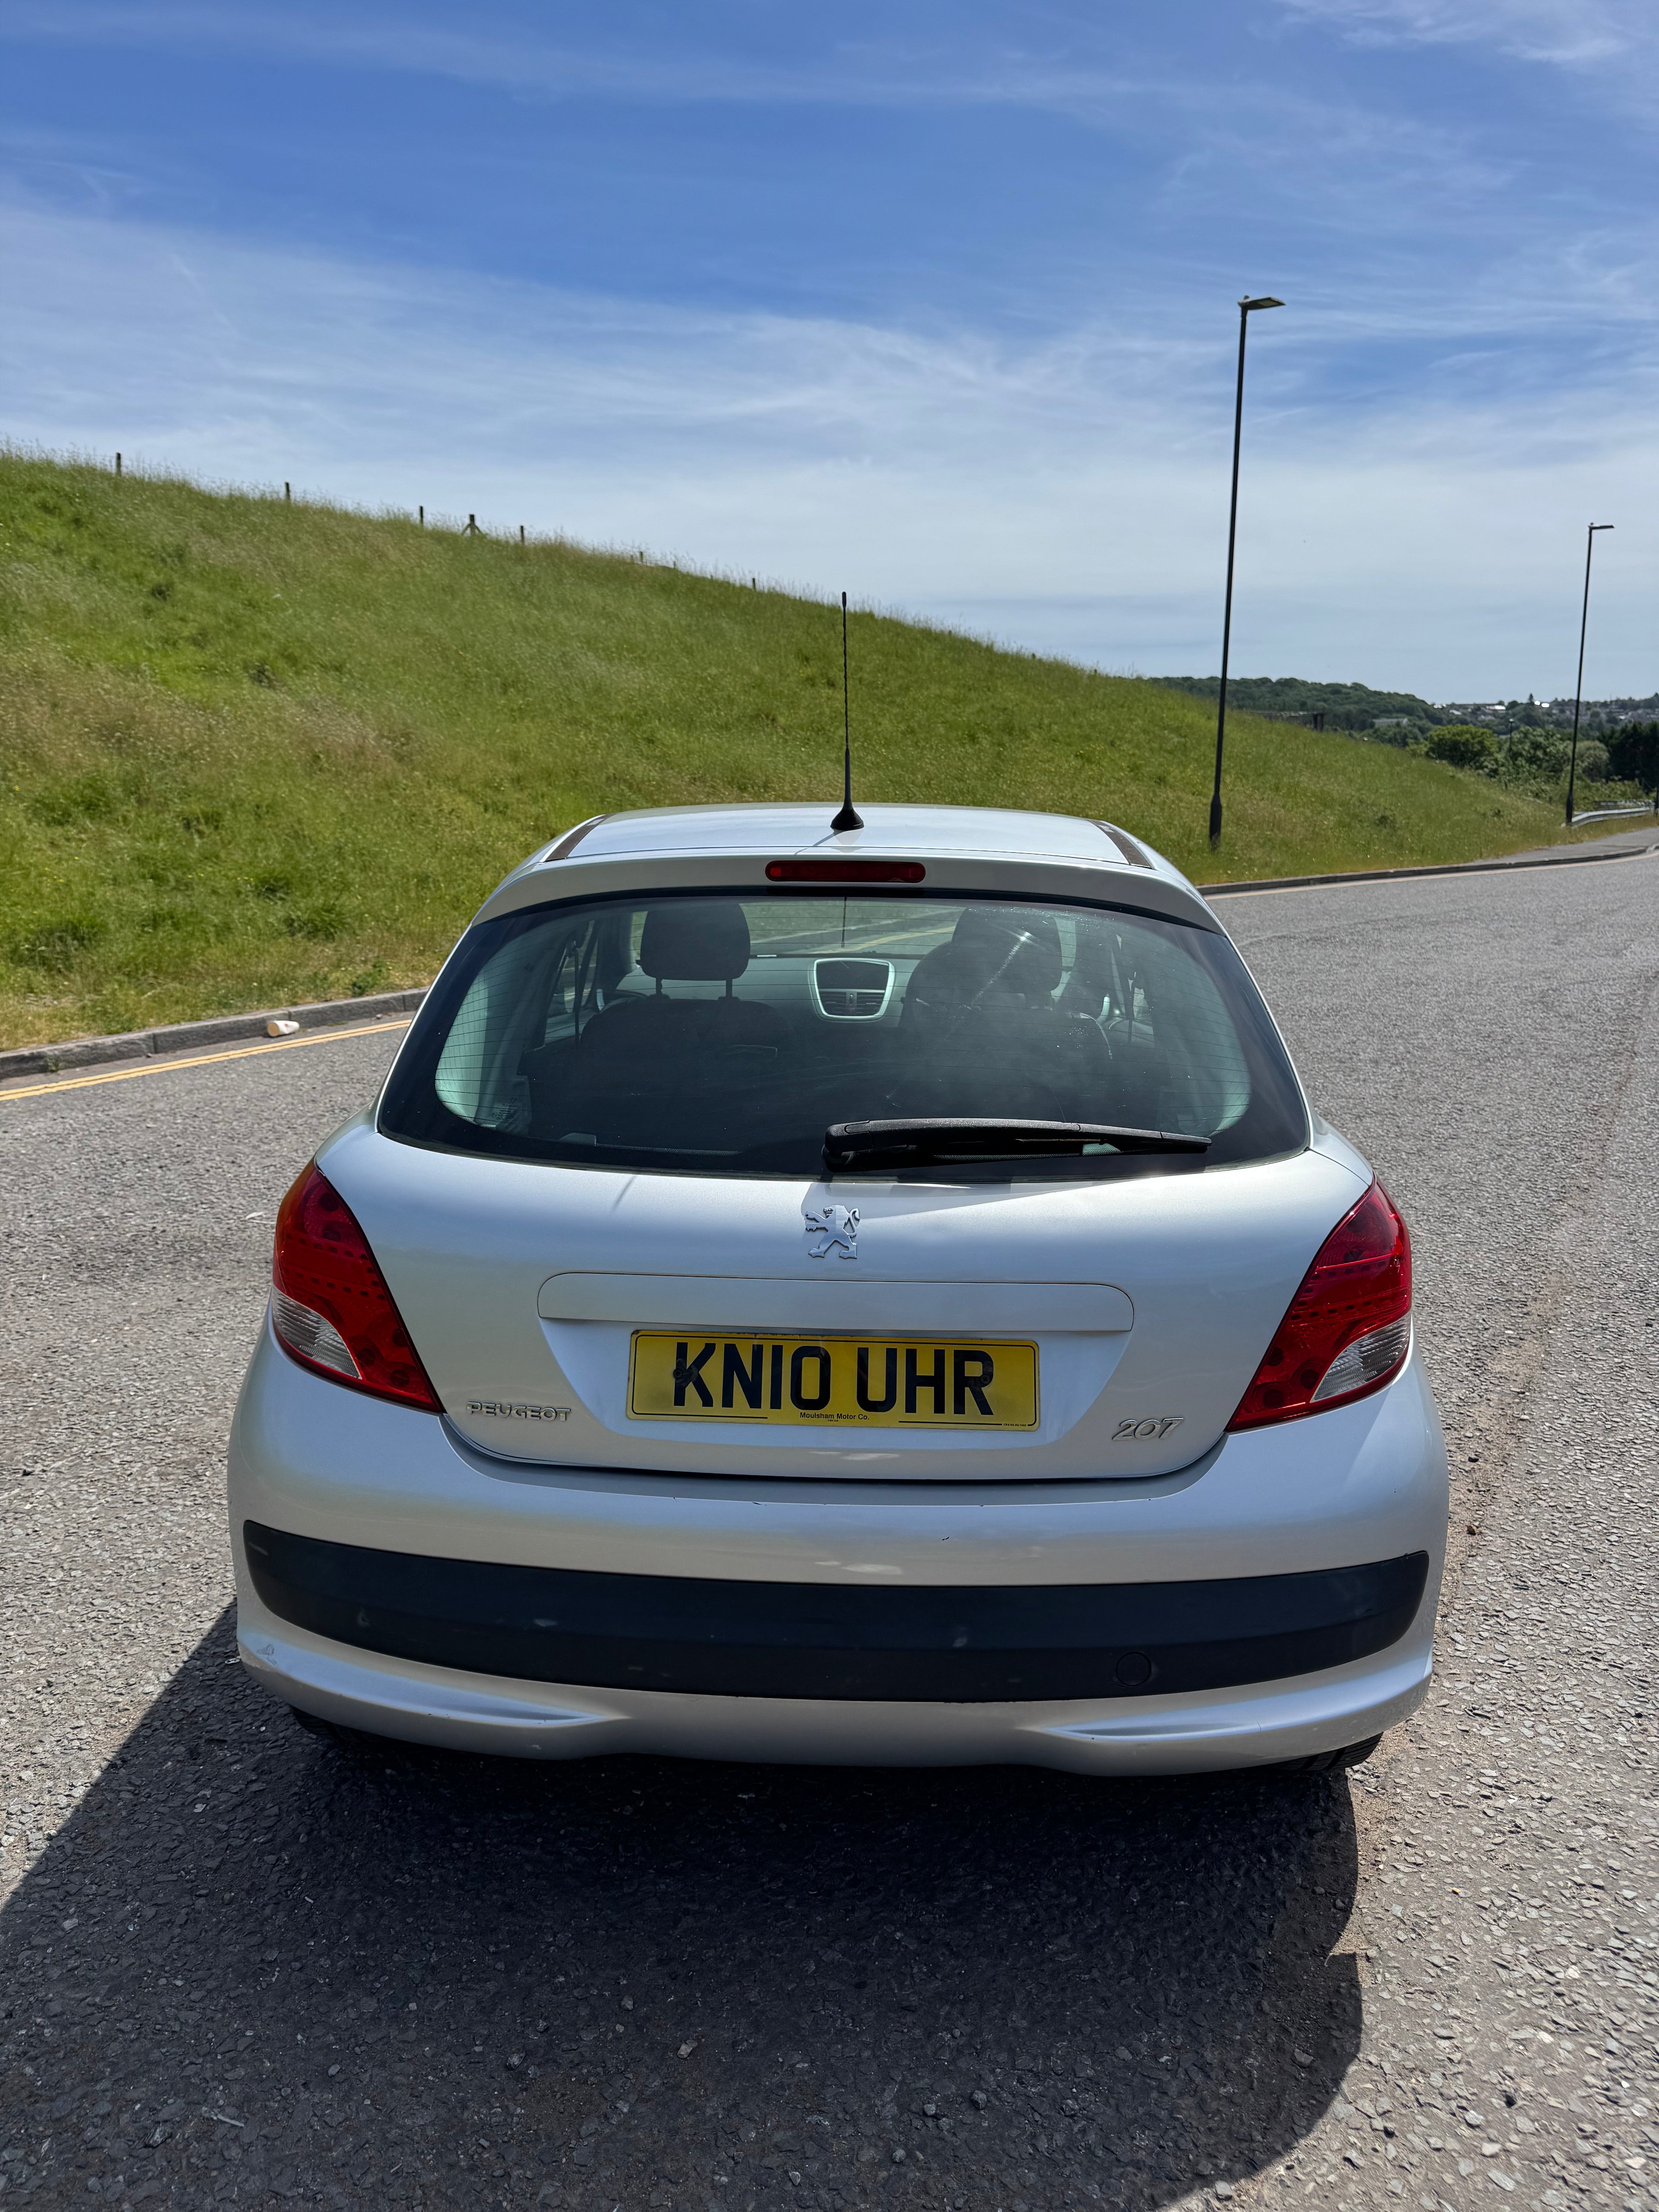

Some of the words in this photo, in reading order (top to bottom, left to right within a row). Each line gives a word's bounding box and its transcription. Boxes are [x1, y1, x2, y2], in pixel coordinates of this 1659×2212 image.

[673, 1342, 831, 1410] KN10
[857, 1347, 994, 1415] UHR
[467, 1401, 571, 1422] PEUGEOT
[1111, 1417, 1184, 1441] 207
